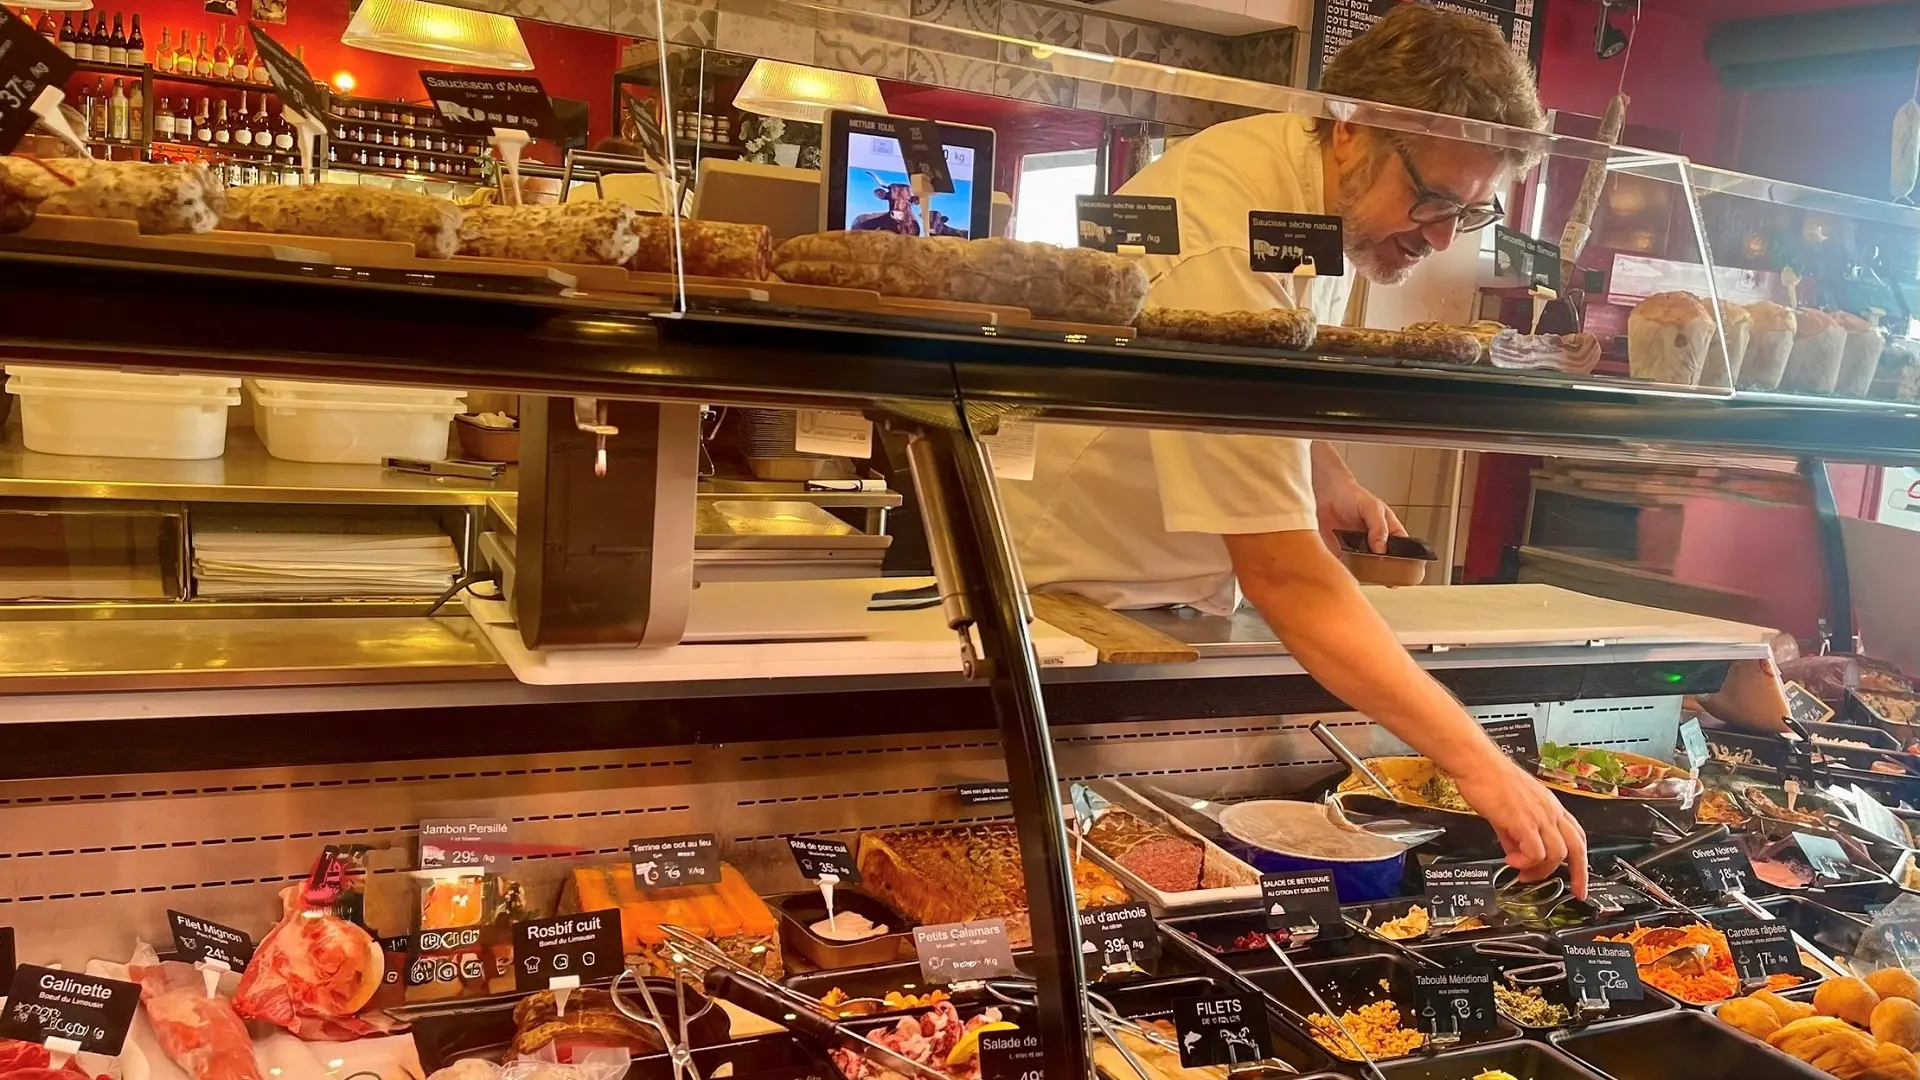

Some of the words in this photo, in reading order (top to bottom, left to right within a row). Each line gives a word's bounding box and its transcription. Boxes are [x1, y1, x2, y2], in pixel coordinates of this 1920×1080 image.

[1328, 5, 1349, 17] COTE
[1327, 15, 1348, 27] COTE
[1350, 20, 1373, 32] SECO
[1326, 25, 1353, 38] CARRE
[426, 76, 494, 92] Saucisson
[496, 81, 538, 94] d'Arles
[849, 118, 876, 129] METTLER
[954, 151, 966, 163] kg
[1252, 217, 1287, 228] Saucisse
[1313, 223, 1338, 231] nature
[1526, 242, 1536, 252] de
[423, 824, 466, 835] Jambon
[468, 823, 508, 834] Persillé
[1692, 848, 1716, 859] Olives
[1715, 846, 1739, 855] Noires
[1425, 869, 1453, 879] Salade
[1453, 869, 1489, 878] Coleslaw
[1262, 879, 1287, 888] SALADE
[1296, 875, 1330, 885] BETTERAVE
[1097, 907, 1147, 923] d'anchois
[177, 915, 201, 931] Filet
[203, 923, 243, 943] Mignon
[527, 920, 574, 940] Rosbif
[576, 917, 602, 933] cuit
[917, 931, 949, 943] Petits
[950, 926, 1001, 939] Calamars
[1726, 927, 1760, 938] Carottes
[558, 937, 567, 945] du
[1563, 944, 1597, 955] Taboulé
[1597, 947, 1631, 957] Libanais
[1416, 974, 1448, 985] Taboulé
[1449, 973, 1490, 984] Méridional
[40, 974, 112, 999] Galinette
[1196, 998, 1242, 1016] FILETS
[983, 1036, 1021, 1050] Salade
[1023, 1034, 1038, 1047] de
